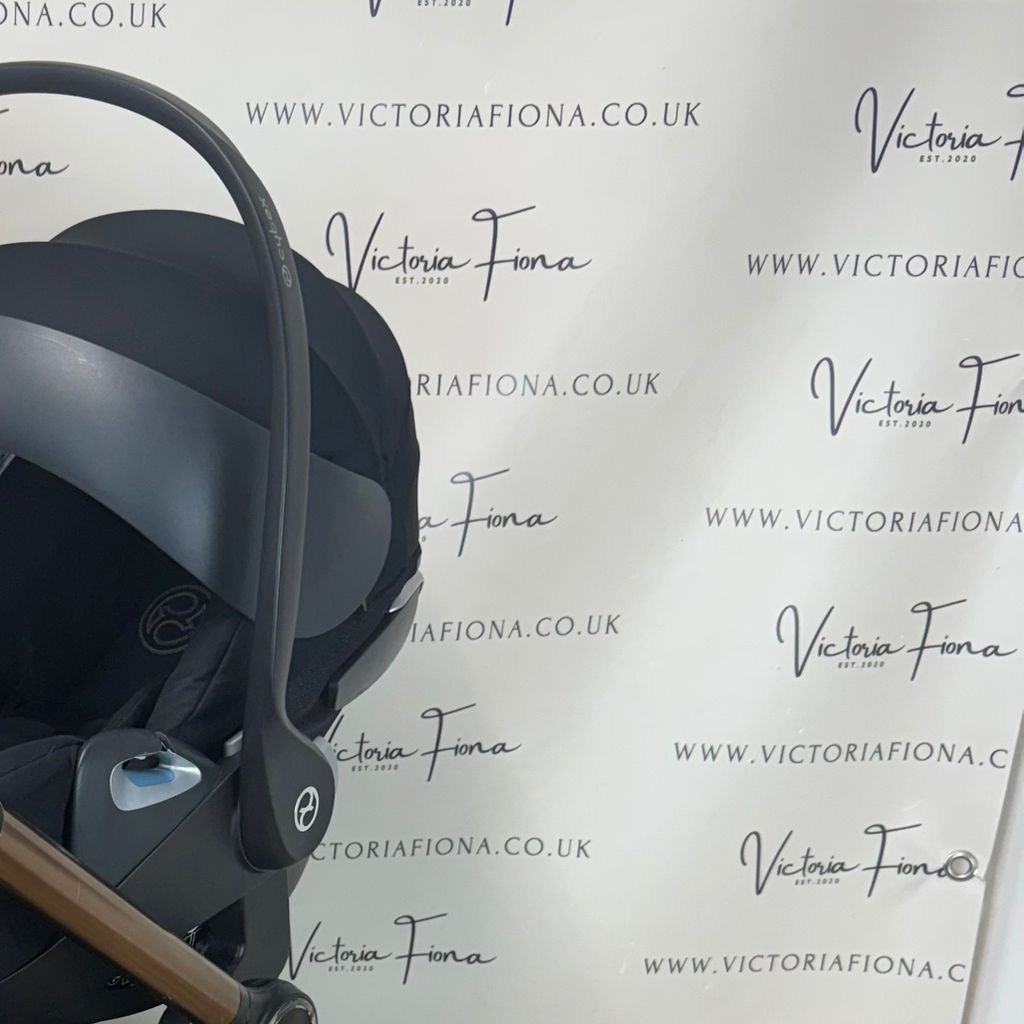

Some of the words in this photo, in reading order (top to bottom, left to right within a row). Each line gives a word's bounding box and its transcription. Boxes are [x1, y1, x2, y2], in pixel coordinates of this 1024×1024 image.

[246, 101, 701, 128] WWW.VICTORIAFIONA.CO.UK
[854, 86, 1002, 174] Victoria
[919, 155, 976, 163] EST.2020
[325, 212, 471, 293] Victoria
[472, 205, 592, 302] Fiona
[395, 277, 450, 285] EST.2020
[417, 373, 660, 396] RIAFIONA.CO.UK
[810, 357, 954, 436] Victoria
[879, 420, 931, 428] EST.2020
[450, 468, 558, 556] Fiona
[411, 615, 621, 642] IAFIONA.CO.UK
[776, 604, 906, 678] Victoria
[907, 599, 1018, 681] Fiona
[421, 703, 522, 782] Fiona
[311, 836, 591, 860] CTORIAFIONA.CO.UK
[740, 831, 860, 896] Victoria
[394, 913, 497, 985] Fiona
